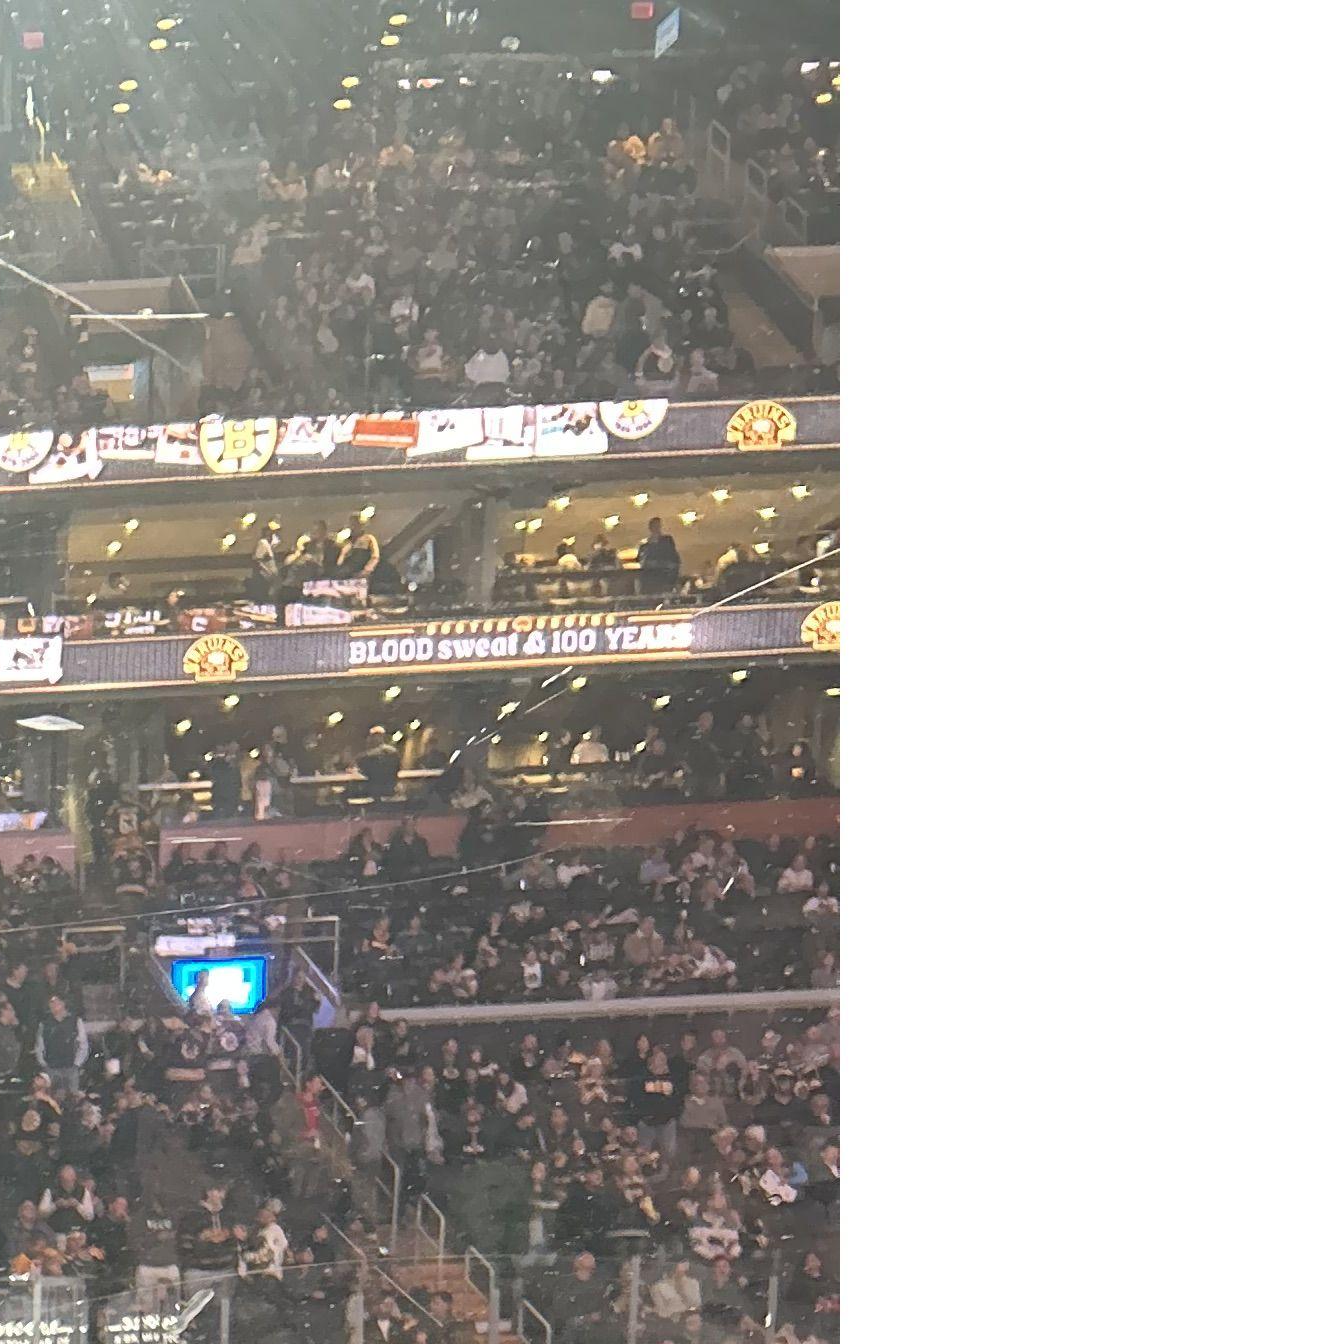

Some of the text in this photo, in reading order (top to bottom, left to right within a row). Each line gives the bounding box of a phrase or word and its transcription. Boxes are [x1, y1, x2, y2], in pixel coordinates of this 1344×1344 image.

[348, 637, 432, 666] BLOOD
[437, 631, 519, 660] sweat
[552, 627, 597, 653] 100
[608, 622, 694, 652] YEARS
